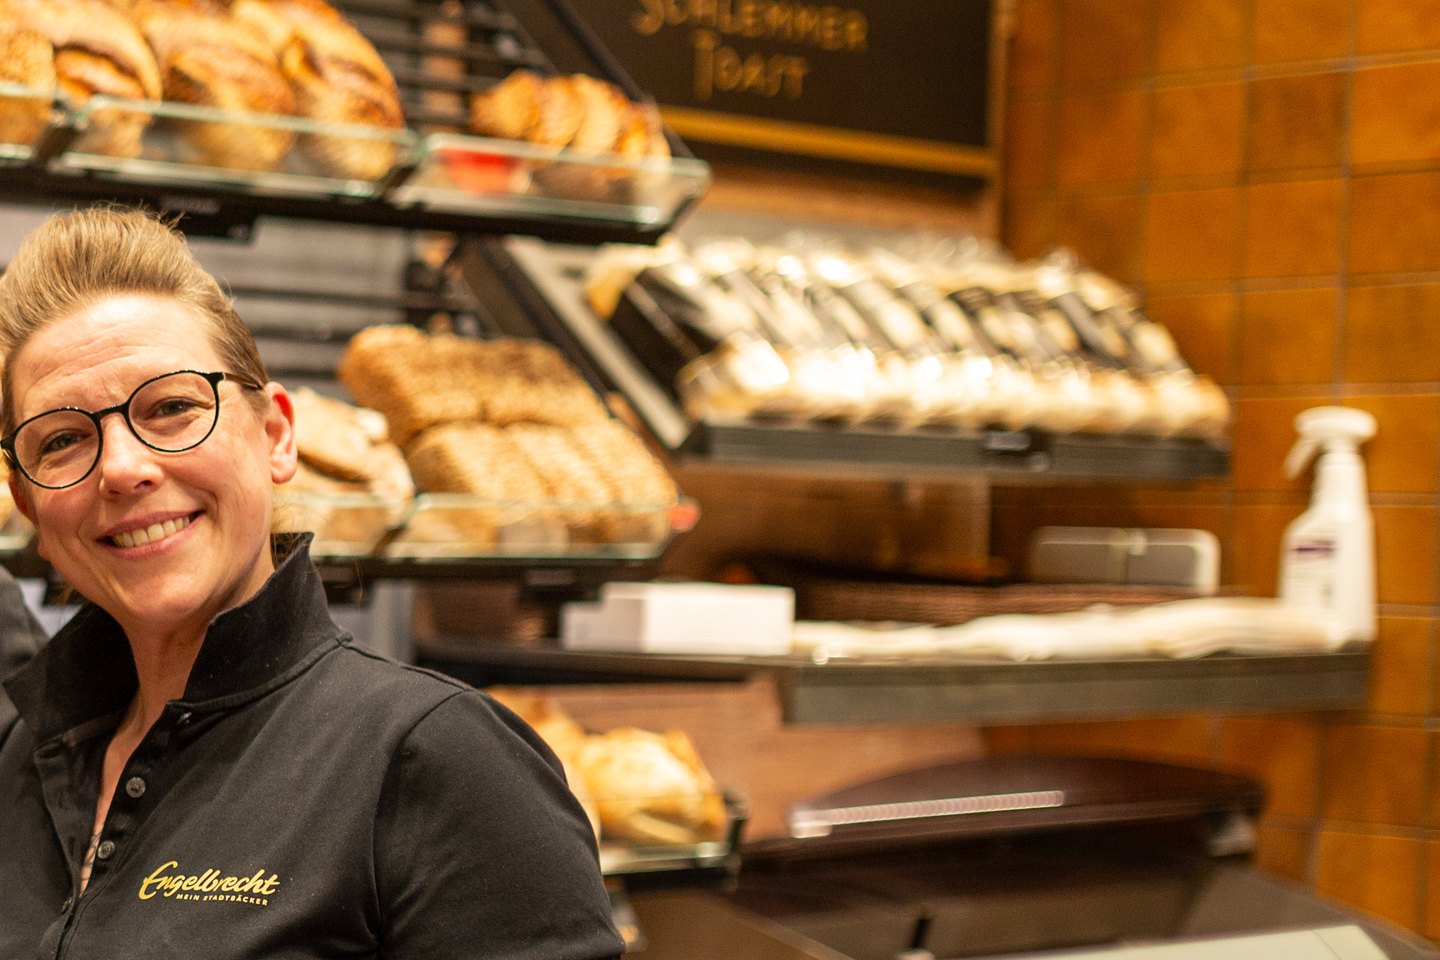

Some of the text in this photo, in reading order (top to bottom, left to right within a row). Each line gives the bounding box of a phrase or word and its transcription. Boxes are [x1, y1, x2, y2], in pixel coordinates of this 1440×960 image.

[138, 860, 281, 900] Engelbrecht
[176, 893, 268, 906] MEIN STADTBÄCKER
